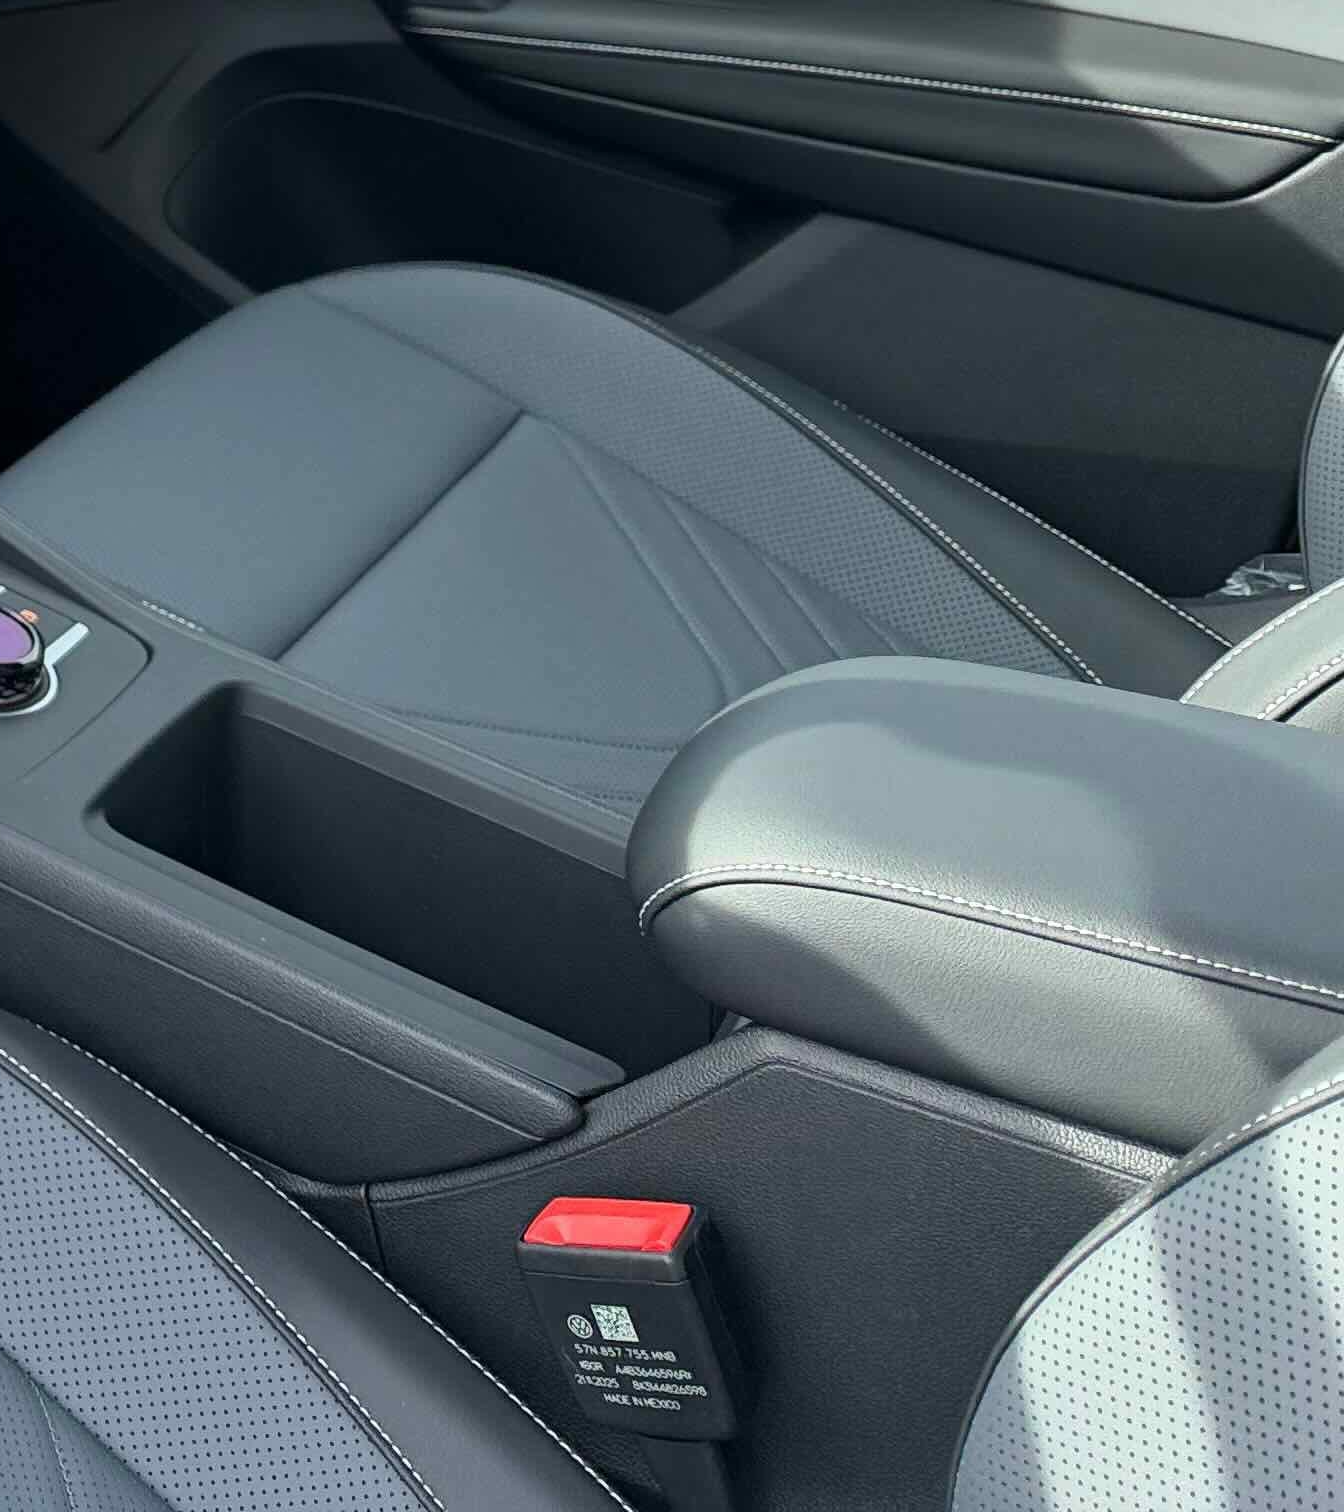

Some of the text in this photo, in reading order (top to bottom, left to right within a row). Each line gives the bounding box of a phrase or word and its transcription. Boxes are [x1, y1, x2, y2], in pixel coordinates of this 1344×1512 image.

[603, 1392, 681, 1411] MADE IN MEXICO
